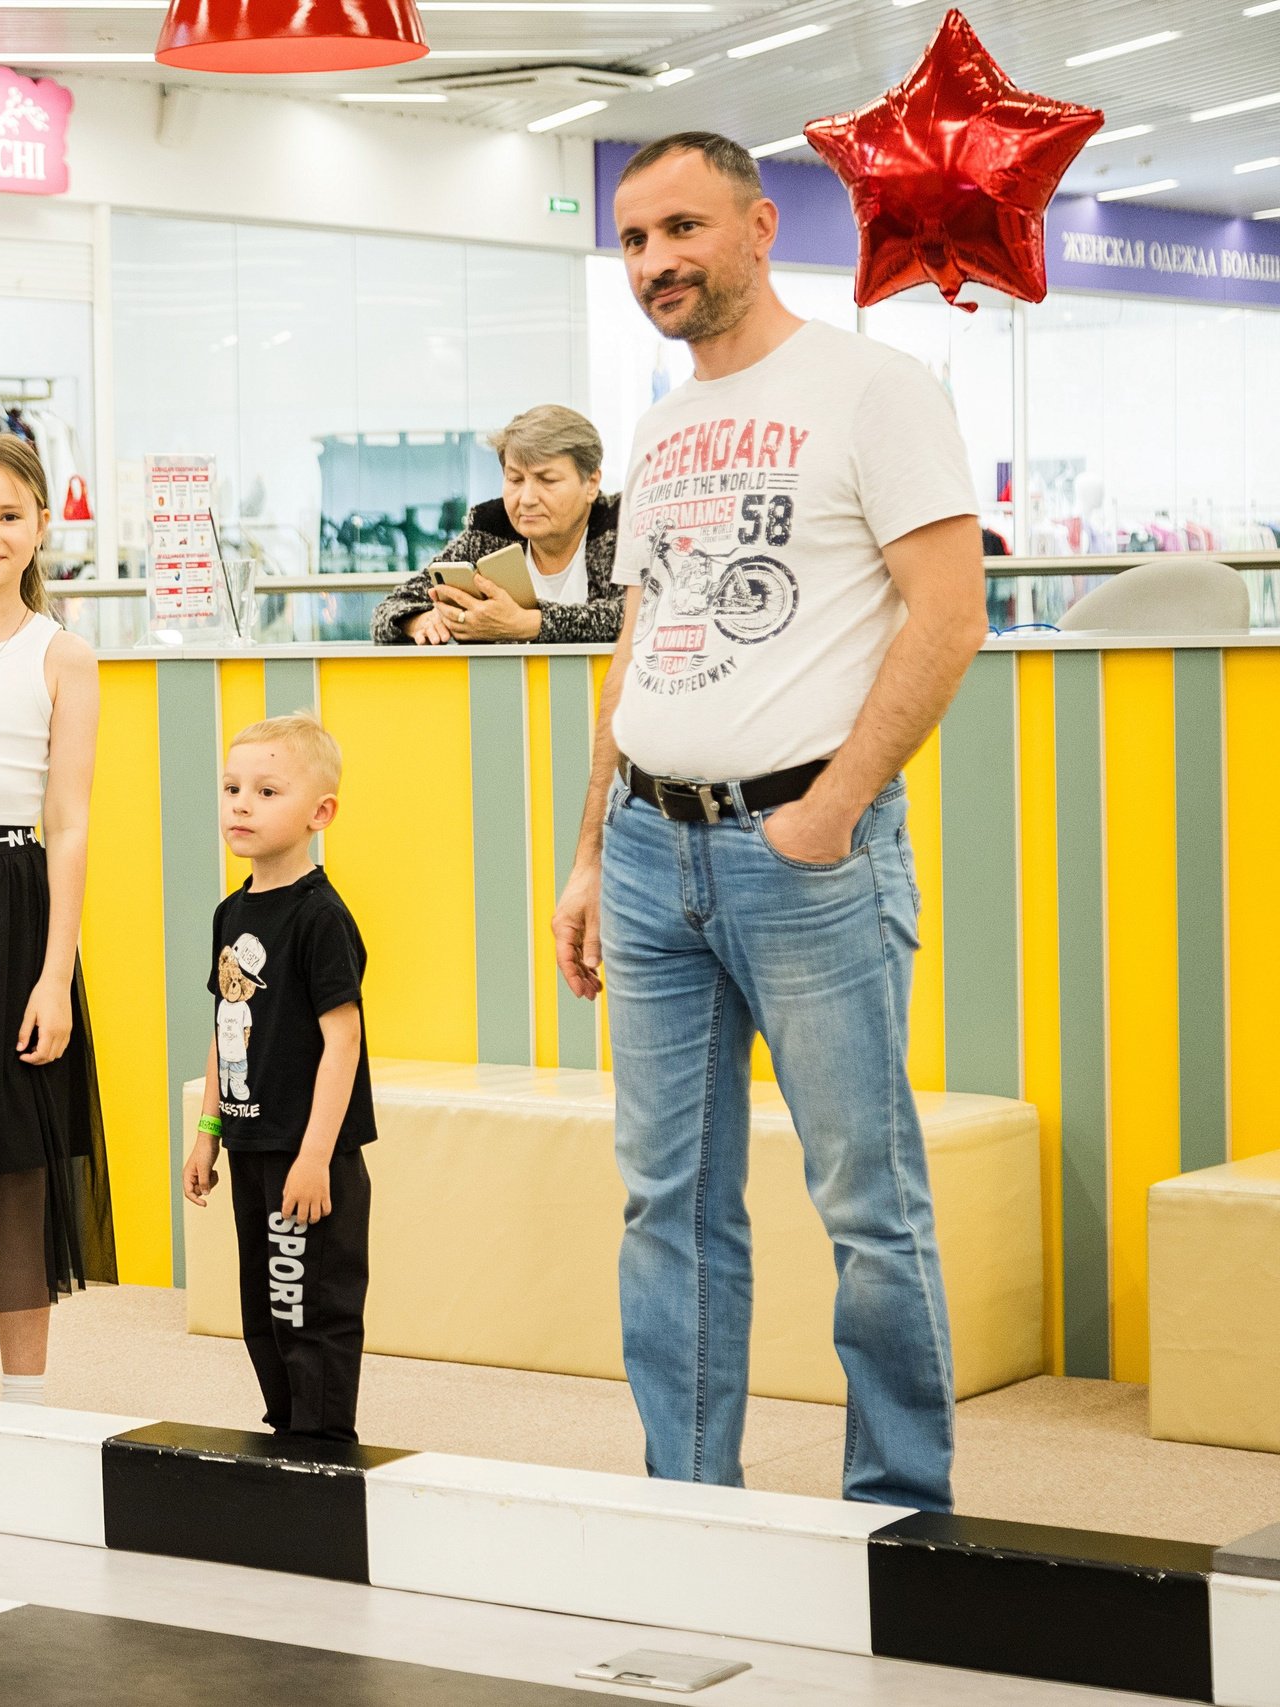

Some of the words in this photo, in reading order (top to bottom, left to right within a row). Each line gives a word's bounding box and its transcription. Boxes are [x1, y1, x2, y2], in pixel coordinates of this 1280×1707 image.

[1062, 231, 1146, 269] ЖЕНСКАЯ
[1149, 241, 1218, 279] ОДЕЖДА
[642, 418, 810, 488] LEGENDARY
[648, 482, 671, 504] KING
[674, 478, 689, 499] OF
[693, 475, 715, 495] THE
[720, 472, 767, 492] WORLD
[635, 498, 734, 536] PERFORMANCE
[737, 493, 794, 547] 58
[656, 627, 704, 650] WINNER
[661, 656, 687, 673] TEAM
[669, 655, 737, 695] SPEEDWAY
[268, 1211, 308, 1328] SPORT
